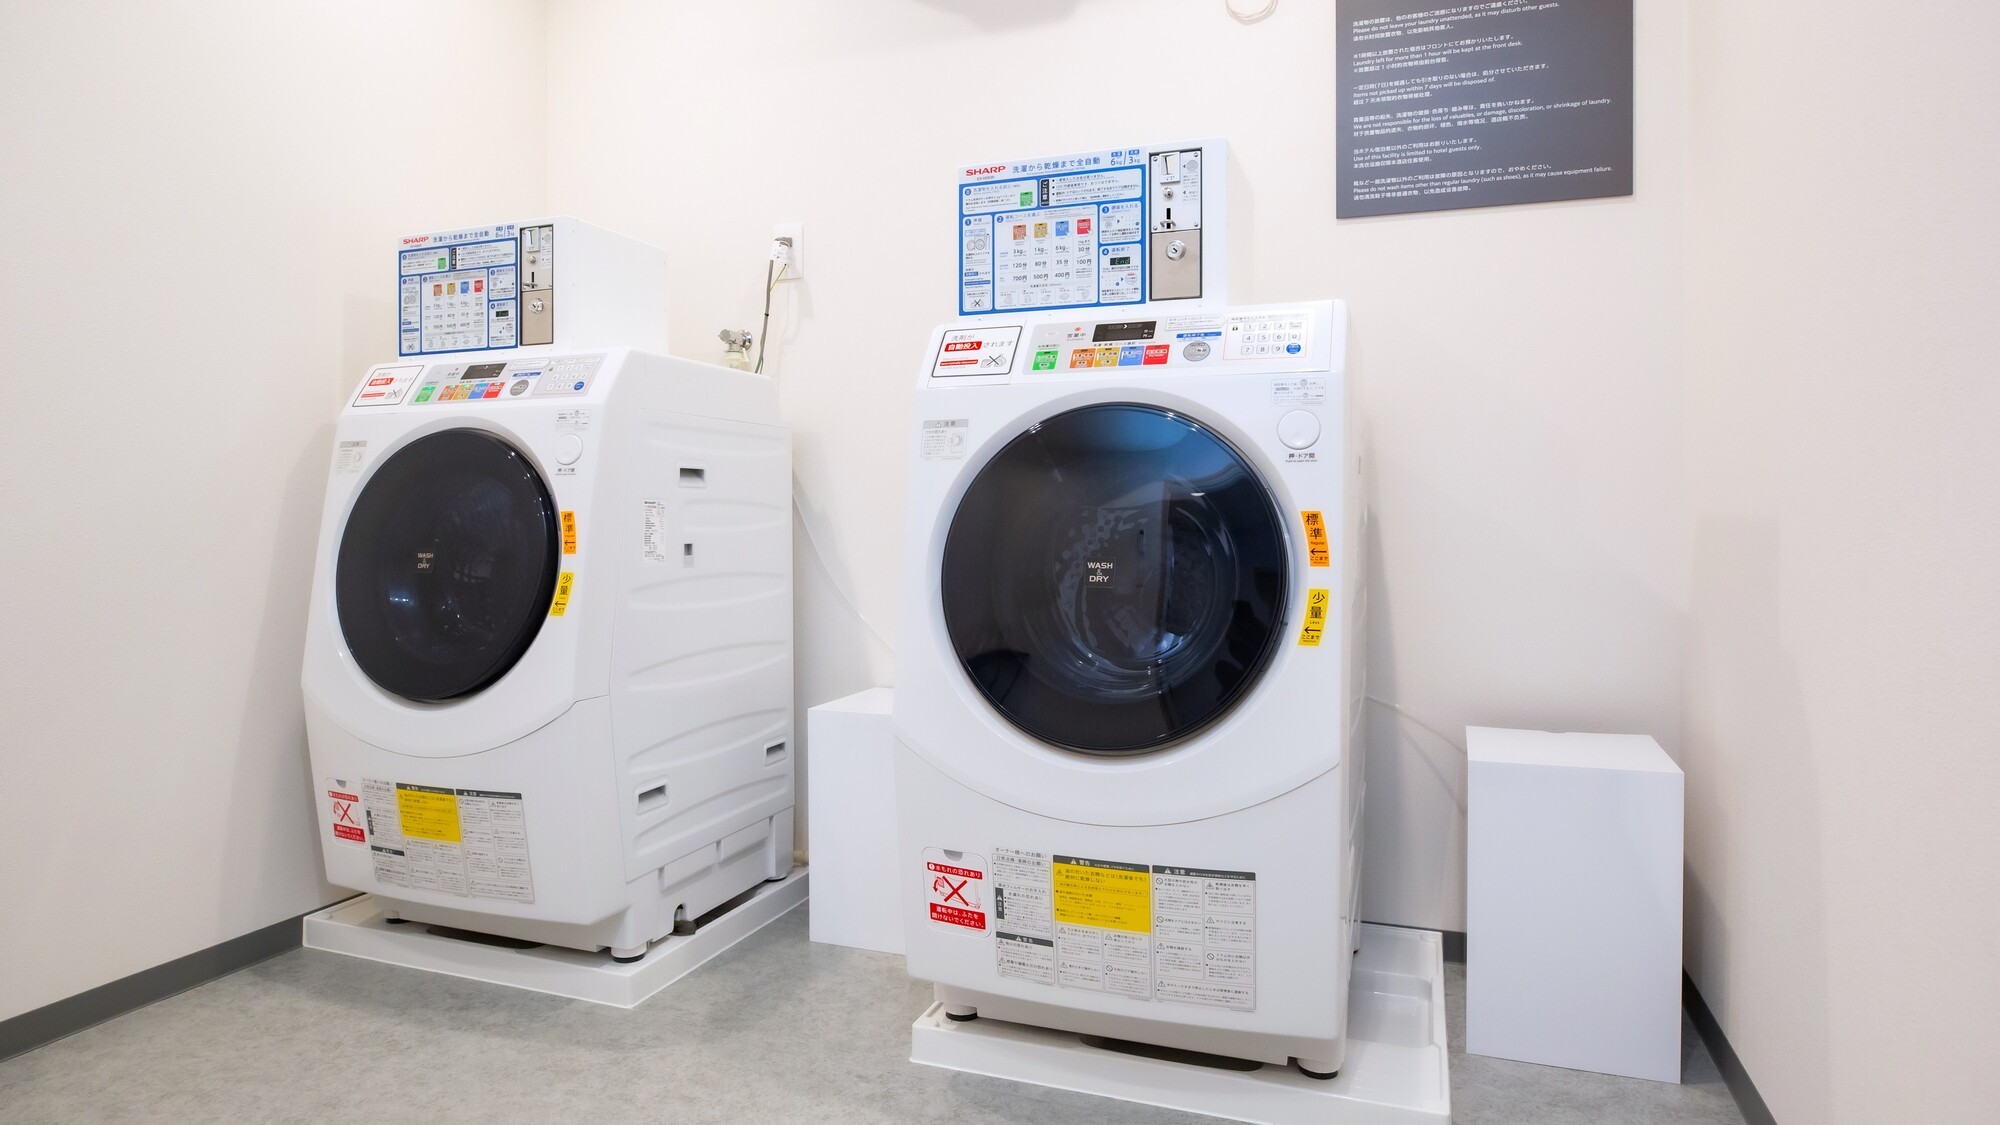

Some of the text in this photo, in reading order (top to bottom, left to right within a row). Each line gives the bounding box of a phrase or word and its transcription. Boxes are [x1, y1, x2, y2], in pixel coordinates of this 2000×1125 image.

[1439, 12, 1473, 22] unattended,
[1537, 0, 1560, 10] guests.
[1461, 77, 1487, 85] disposed
[966, 166, 1006, 176] SHARP
[1012, 156, 1100, 174] 洗濯から乾燥まで全自動
[1306, 514, 1322, 539] 標準
[560, 574, 571, 595] 少量
[1310, 592, 1325, 619] 少量
[935, 866, 981, 878] 水もれの恐れあり
[932, 913, 984, 928] 開けないでください。
[936, 906, 979, 920] 運転中は、ふたを
